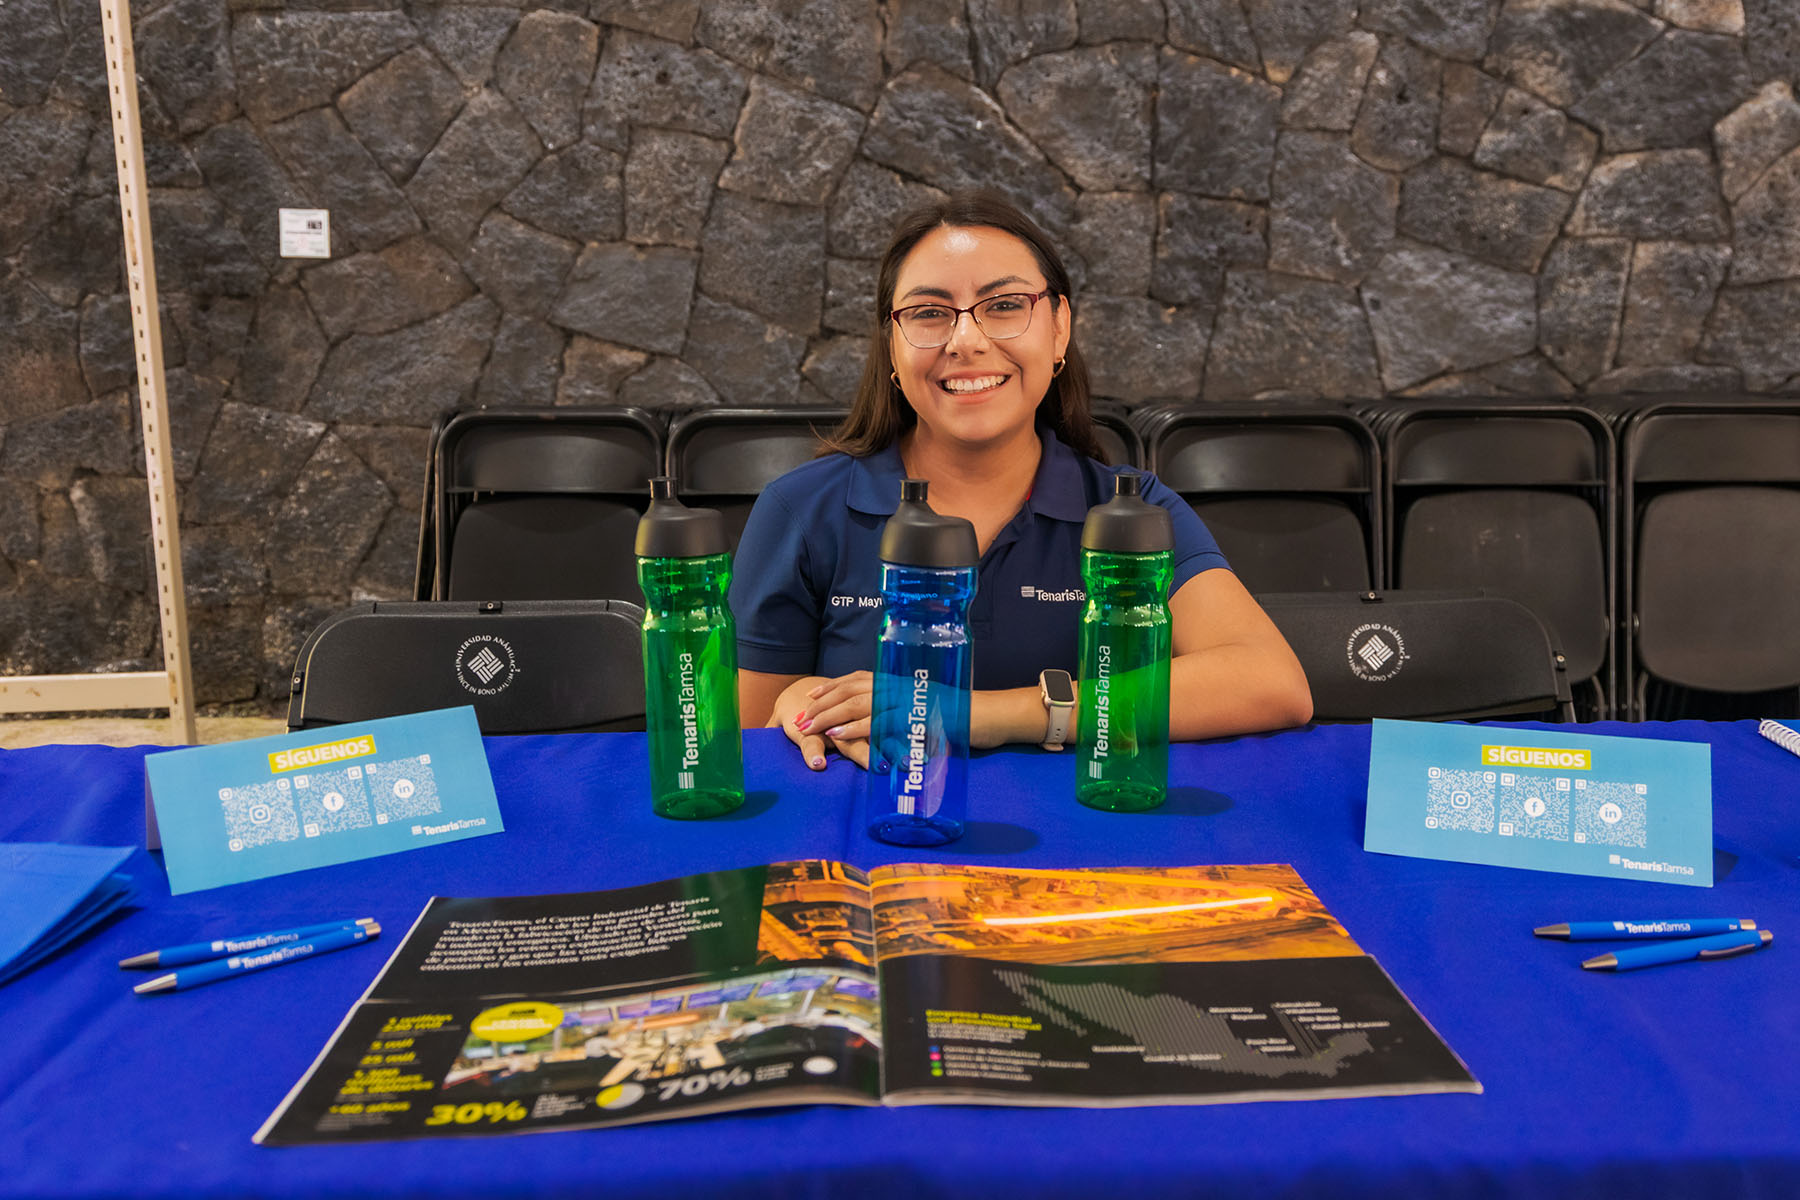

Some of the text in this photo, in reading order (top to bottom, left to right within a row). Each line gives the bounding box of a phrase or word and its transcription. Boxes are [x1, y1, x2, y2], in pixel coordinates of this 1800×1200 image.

[831, 596, 854, 607] GTP
[1035, 589, 1086, 601] TenarisTa
[1347, 623, 1405, 656] UNIVERSIDAD ANÁHUAC
[456, 635, 516, 671] UNIVERSIDAD ANÁHUAC
[678, 652, 699, 770] TenarisTamsa
[1094, 645, 1111, 759] TenarisTamsa
[904, 668, 929, 794] TenarisTamsa
[275, 738, 371, 771] SÍGUENOS
[1488, 746, 1586, 768] SÍGUENOS
[422, 816, 486, 836] TenarisTamsa
[1621, 857, 1694, 876] TenarisTamsa
[1625, 922, 1691, 934] TenarisTamsa
[225, 932, 299, 952] TenarisTamsa
[242, 943, 314, 970] TenarisTamsa
[657, 1065, 752, 1102] 70%
[424, 1100, 528, 1126] 30%
